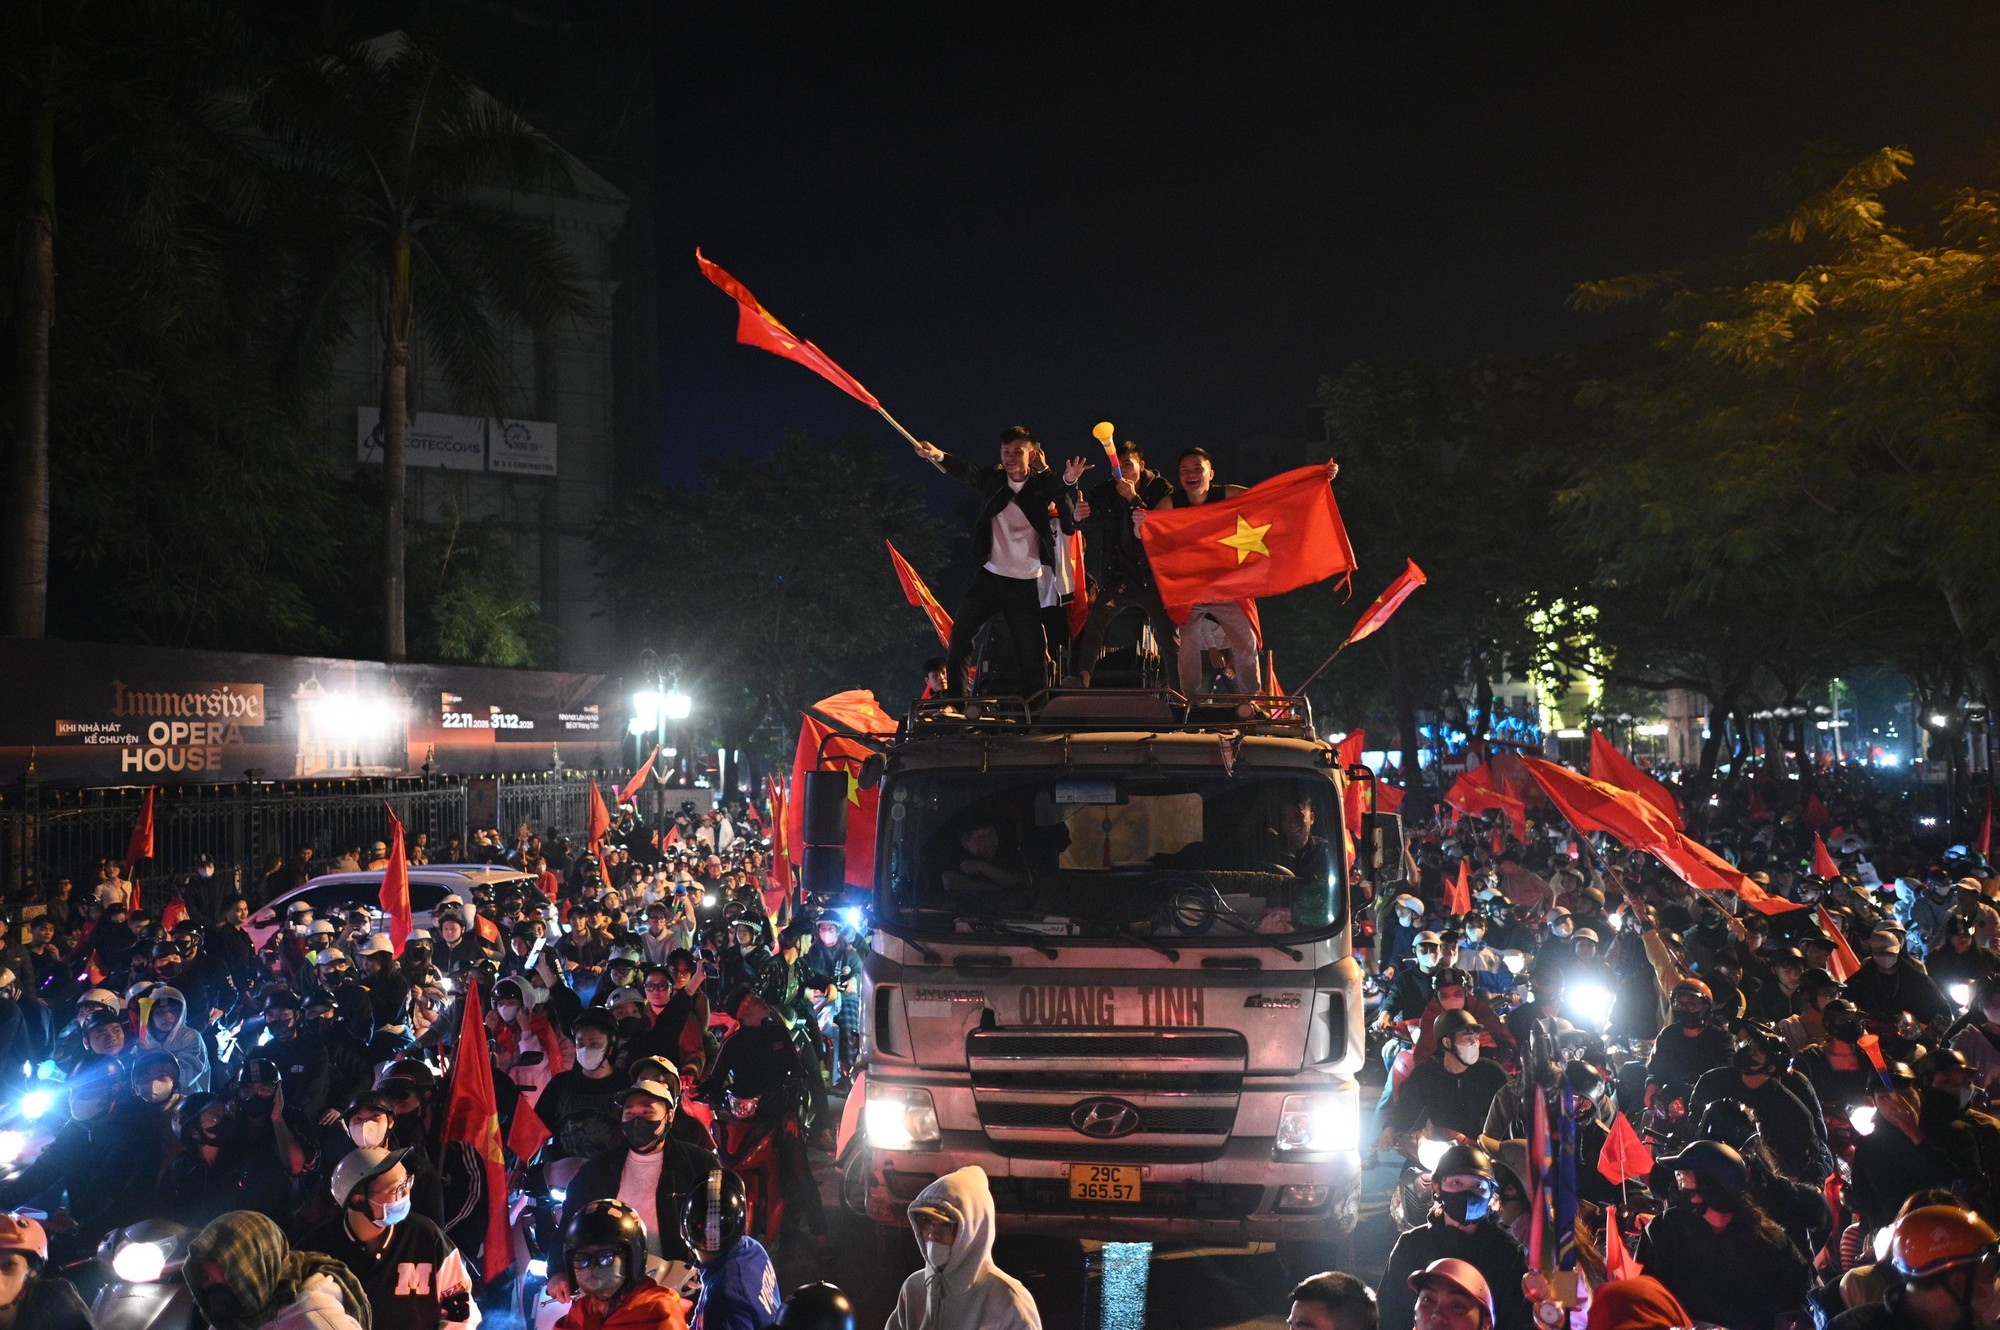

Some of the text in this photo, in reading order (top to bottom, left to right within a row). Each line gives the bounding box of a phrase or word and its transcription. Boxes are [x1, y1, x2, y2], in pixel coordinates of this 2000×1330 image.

[109, 680, 258, 717] Immersive
[59, 722, 121, 732] KHI NHÀ HÁT
[85, 732, 138, 745] KỂ CHUYỆN
[148, 721, 243, 745] OPERA
[122, 747, 221, 772] HOUSE
[1138, 986, 1204, 1026] TINH
[1091, 1167, 1120, 1182] 29C
[1078, 1183, 1132, 1199] 365.57
[395, 1262, 432, 1295] M
